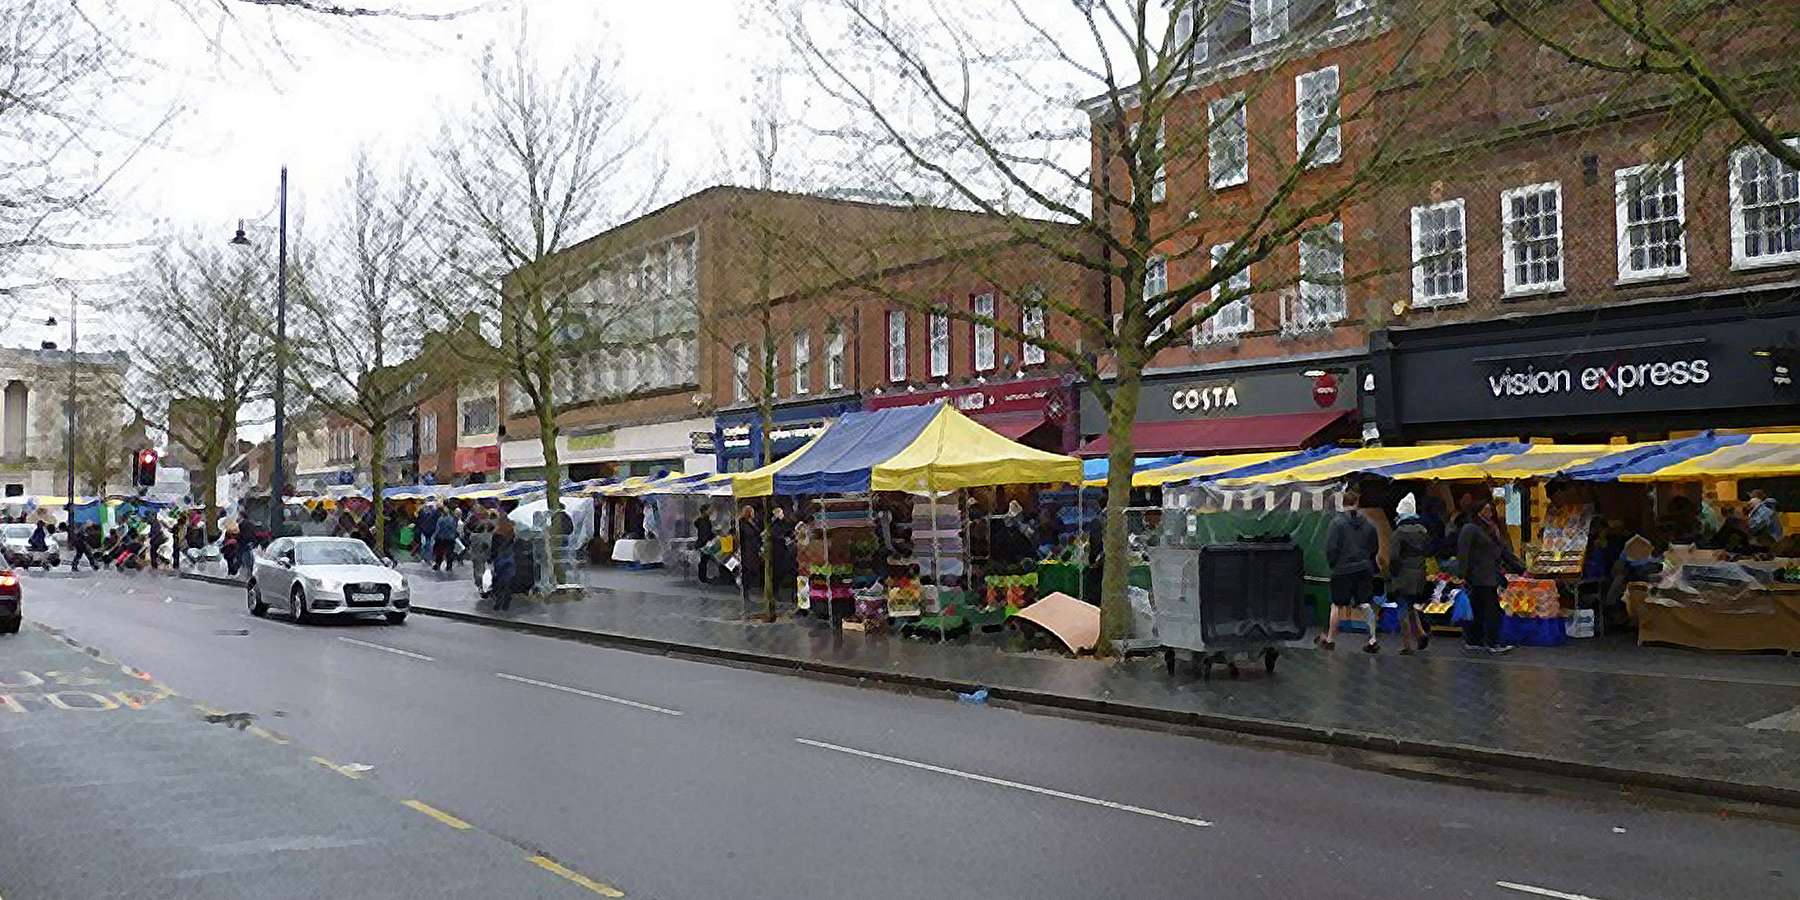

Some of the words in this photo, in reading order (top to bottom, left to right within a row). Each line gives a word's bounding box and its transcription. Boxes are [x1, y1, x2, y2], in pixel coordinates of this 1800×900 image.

[1488, 365, 1571, 397] vision
[1580, 359, 1710, 396] express
[1171, 386, 1239, 411] COSTA
